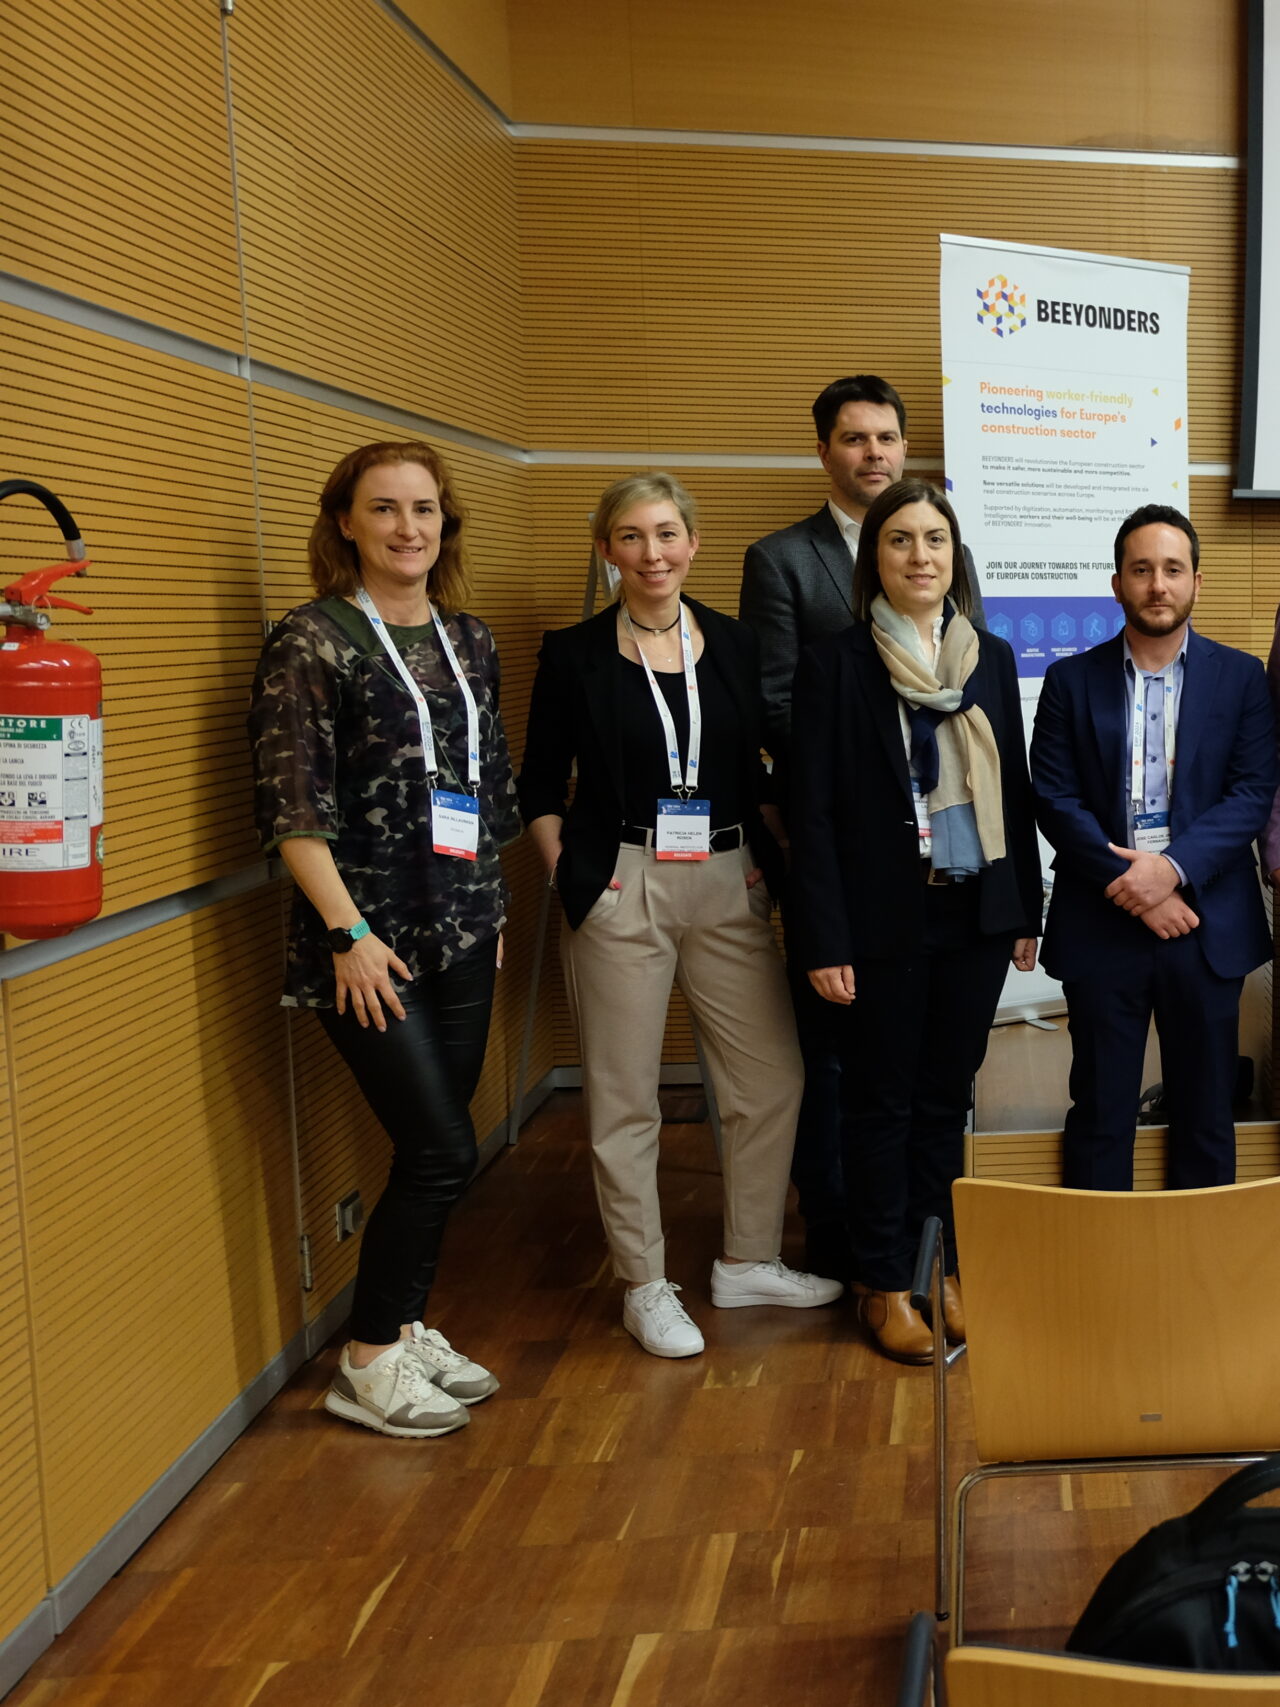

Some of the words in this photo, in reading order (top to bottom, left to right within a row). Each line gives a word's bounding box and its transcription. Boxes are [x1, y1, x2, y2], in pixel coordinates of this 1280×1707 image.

[1037, 299, 1160, 335] BEEYONDERS
[980, 381, 1043, 402] Pioneering
[1046, 390, 1133, 408] worker-friendly
[981, 402, 1057, 420] technologies
[1060, 407, 1077, 419] for
[1079, 408, 1126, 425] Europe's
[981, 423, 1057, 437] construction
[1060, 428, 1096, 439] sector
[982, 455, 1014, 463] BEEYONDERS
[1069, 460, 1093, 468] European
[1094, 461, 1127, 469] construction
[984, 504, 1013, 512] Supported
[986, 561, 1002, 570] JOIN
[1004, 562, 1017, 570] OUR
[1019, 562, 1046, 570] JOURNEY
[1048, 562, 1077, 570] TOWARDS
[986, 572, 994, 580] OF
